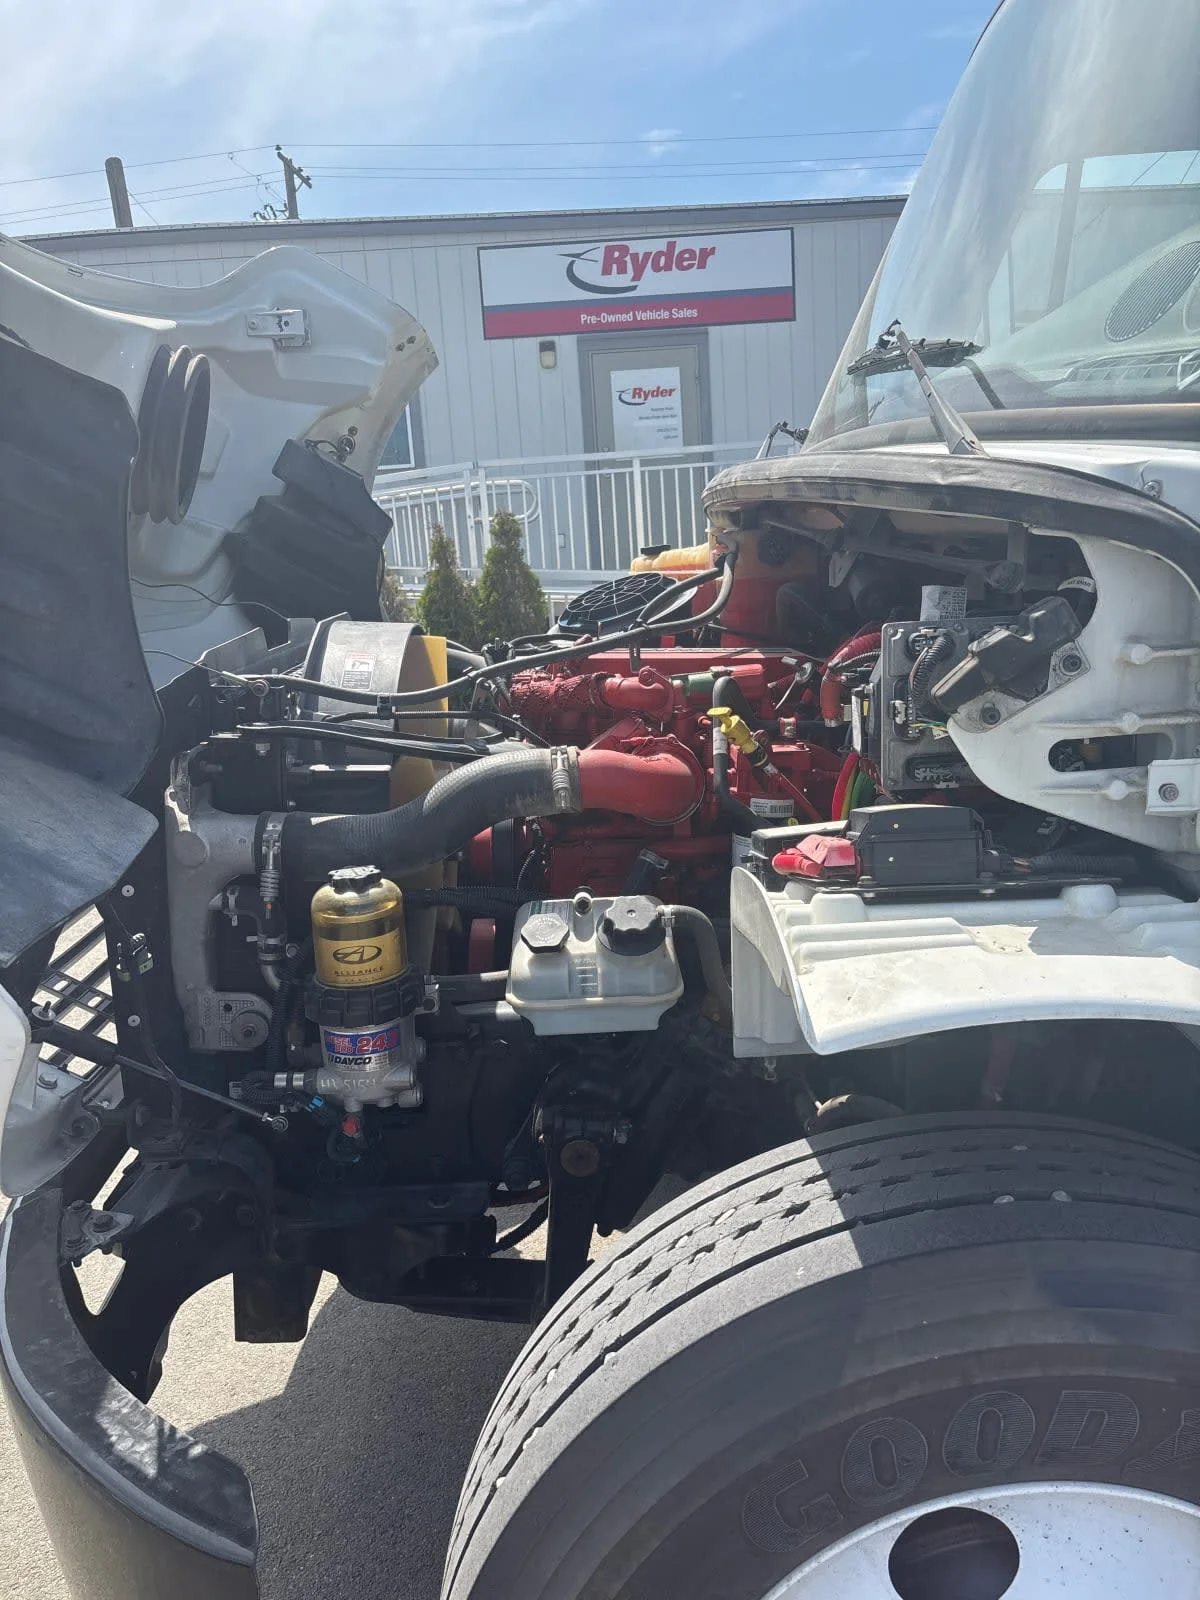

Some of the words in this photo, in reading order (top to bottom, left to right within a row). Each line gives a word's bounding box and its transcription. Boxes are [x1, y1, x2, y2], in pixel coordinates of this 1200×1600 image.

[601, 241, 716, 282] Ryder
[580, 311, 633, 325] Pre-Owned
[635, 309, 670, 321] Vehicle
[671, 308, 699, 319] Sales
[631, 386, 677, 402] Ryder
[334, 1055, 373, 1066] DAYCO
